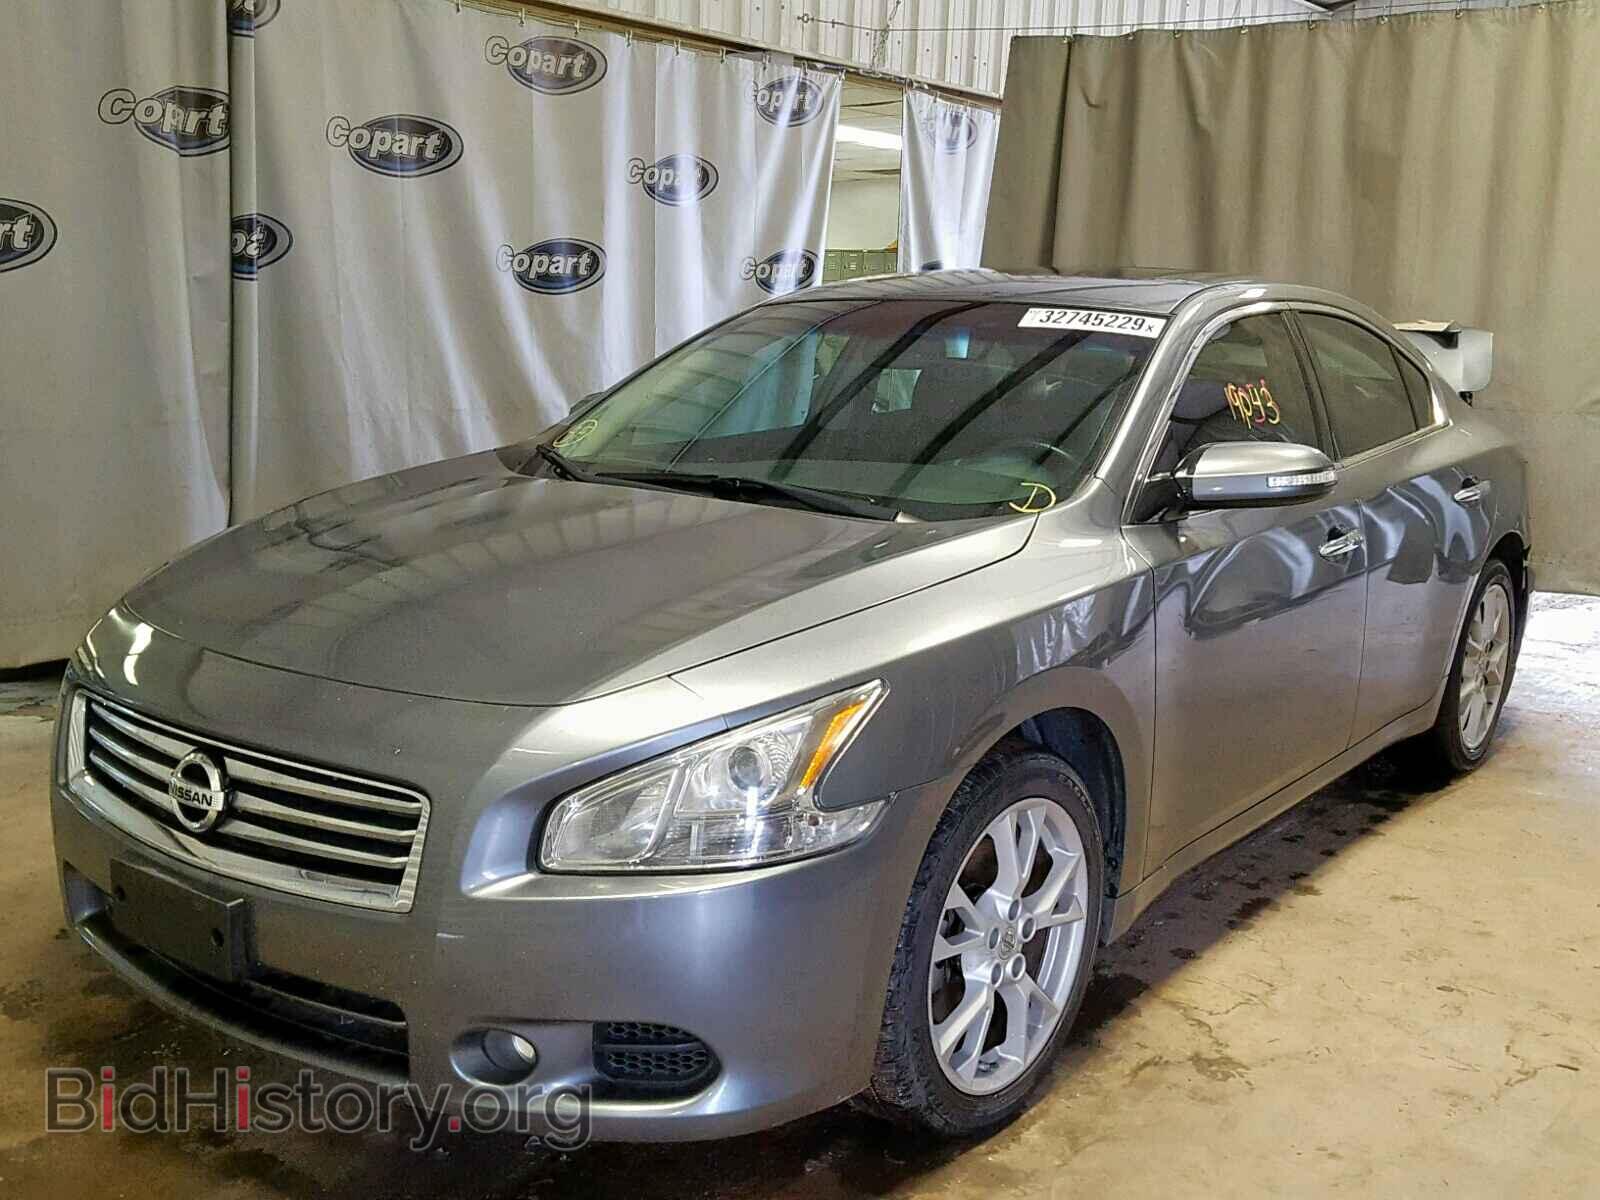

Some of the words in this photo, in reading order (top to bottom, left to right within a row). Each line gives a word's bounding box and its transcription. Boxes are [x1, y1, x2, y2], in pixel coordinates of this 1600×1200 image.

[485, 36, 587, 80] Copart
[326, 116, 443, 160] Copart
[496, 245, 592, 280] Copart
[1039, 310, 1146, 331] 32745229
[169, 778, 213, 807] NISSAN
